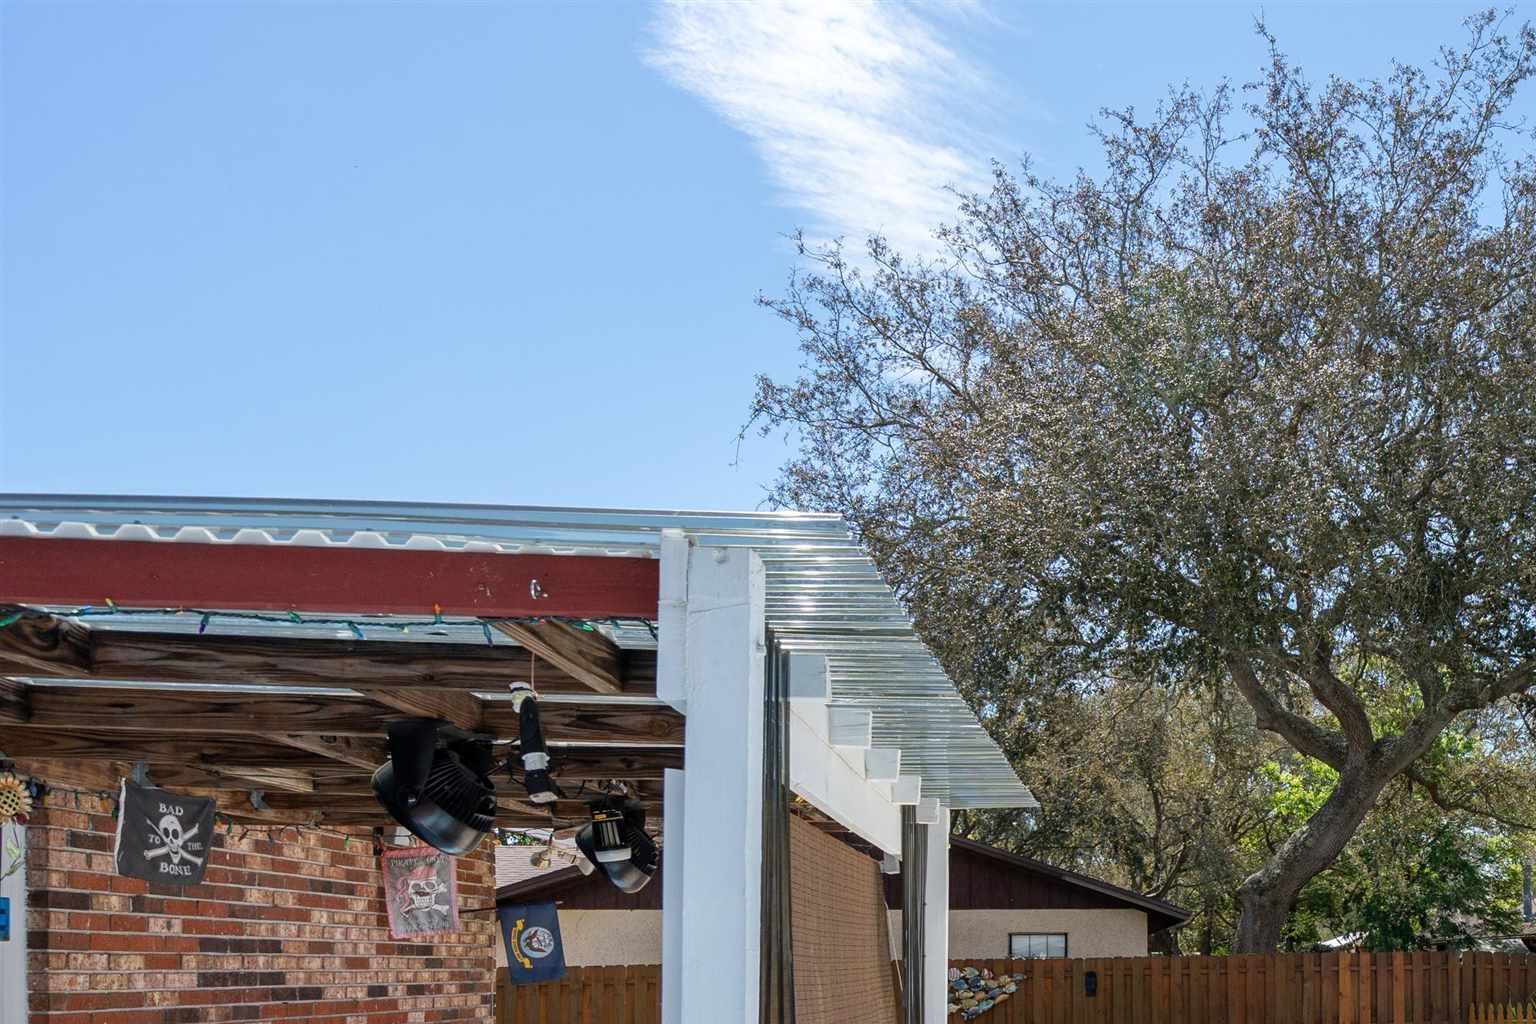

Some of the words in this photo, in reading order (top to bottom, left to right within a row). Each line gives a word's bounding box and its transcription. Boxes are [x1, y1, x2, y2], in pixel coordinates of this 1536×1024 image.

[159, 803, 184, 816] BAD
[147, 834, 161, 845] TO
[187, 842, 204, 851] THE
[159, 862, 192, 876] BONE
